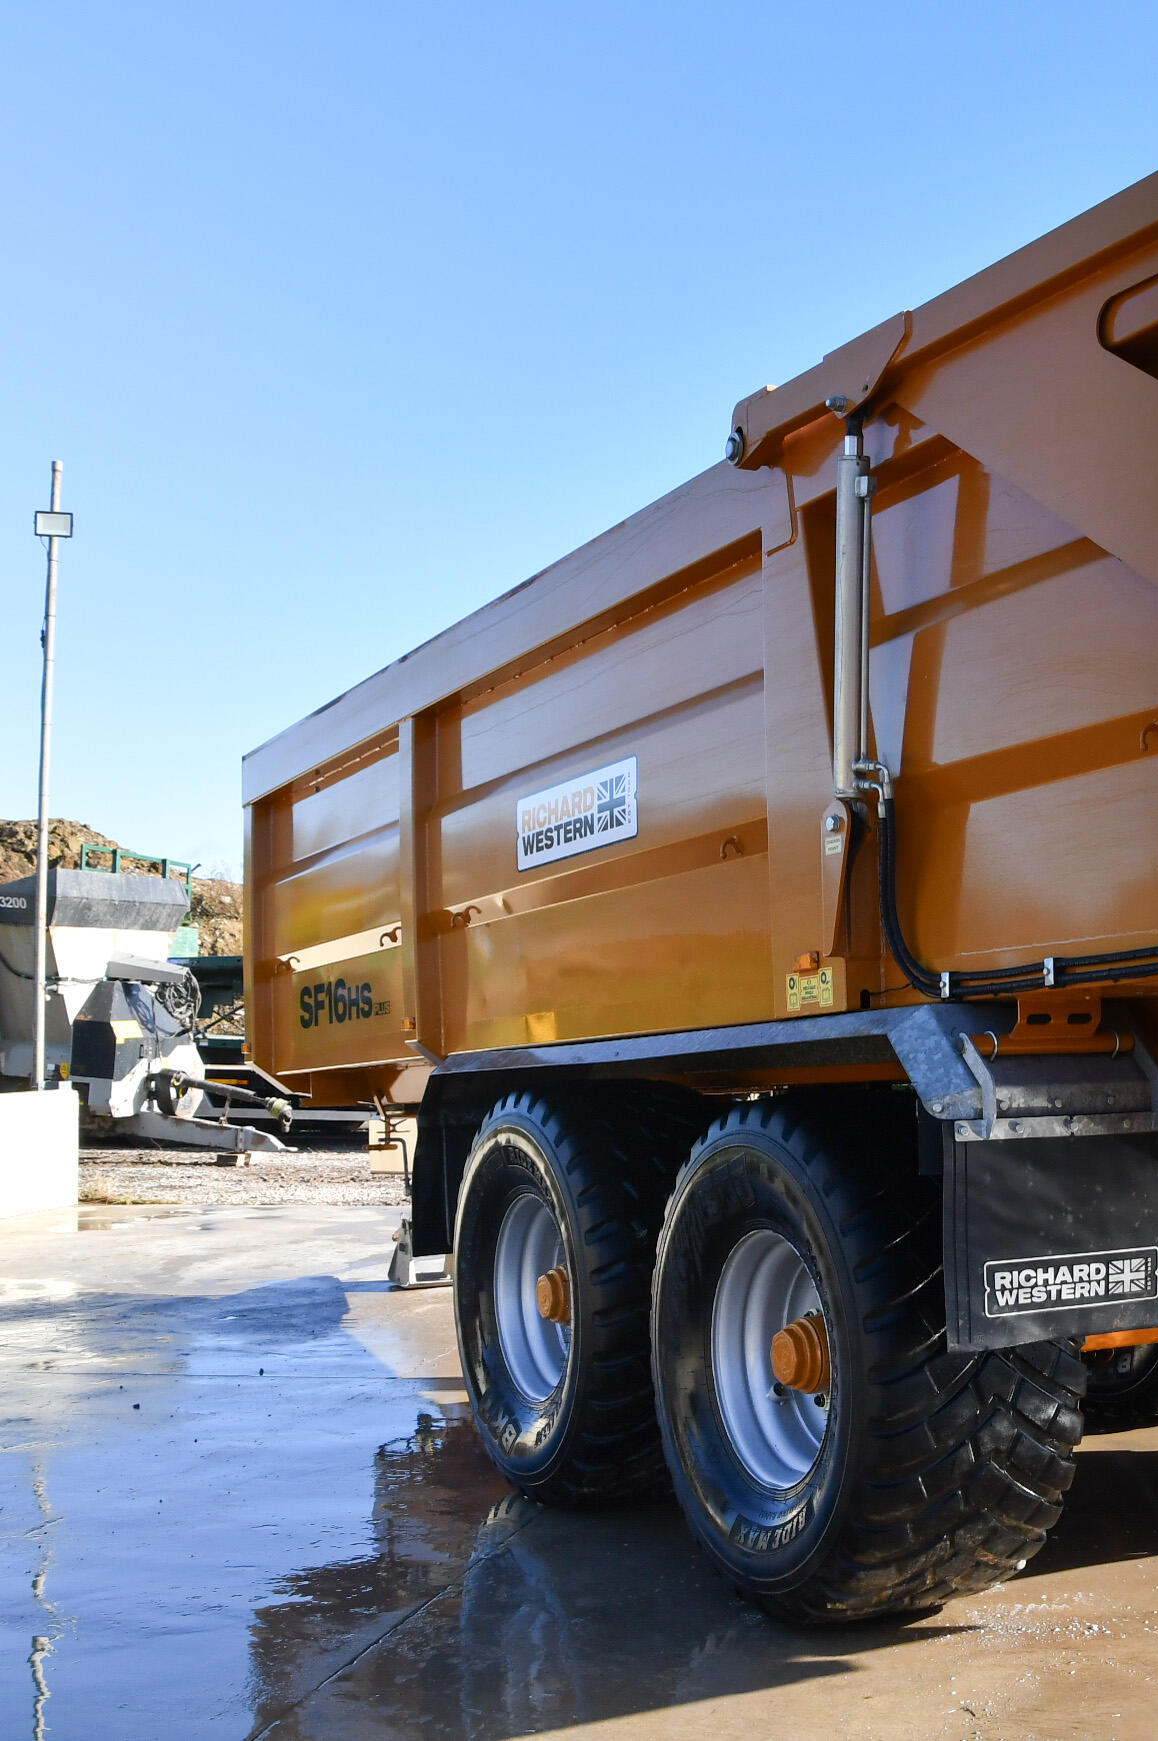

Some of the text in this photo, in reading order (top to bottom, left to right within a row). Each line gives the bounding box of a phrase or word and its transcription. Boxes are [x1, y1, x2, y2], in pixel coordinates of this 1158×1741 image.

[522, 786, 595, 833] RICHARD
[522, 813, 595, 856] WESTERN
[0, 896, 27, 909] 3200
[300, 978, 373, 1029] SF16HS
[994, 1262, 1107, 1290] RICHARD
[995, 1280, 1106, 1307] WESTERN
